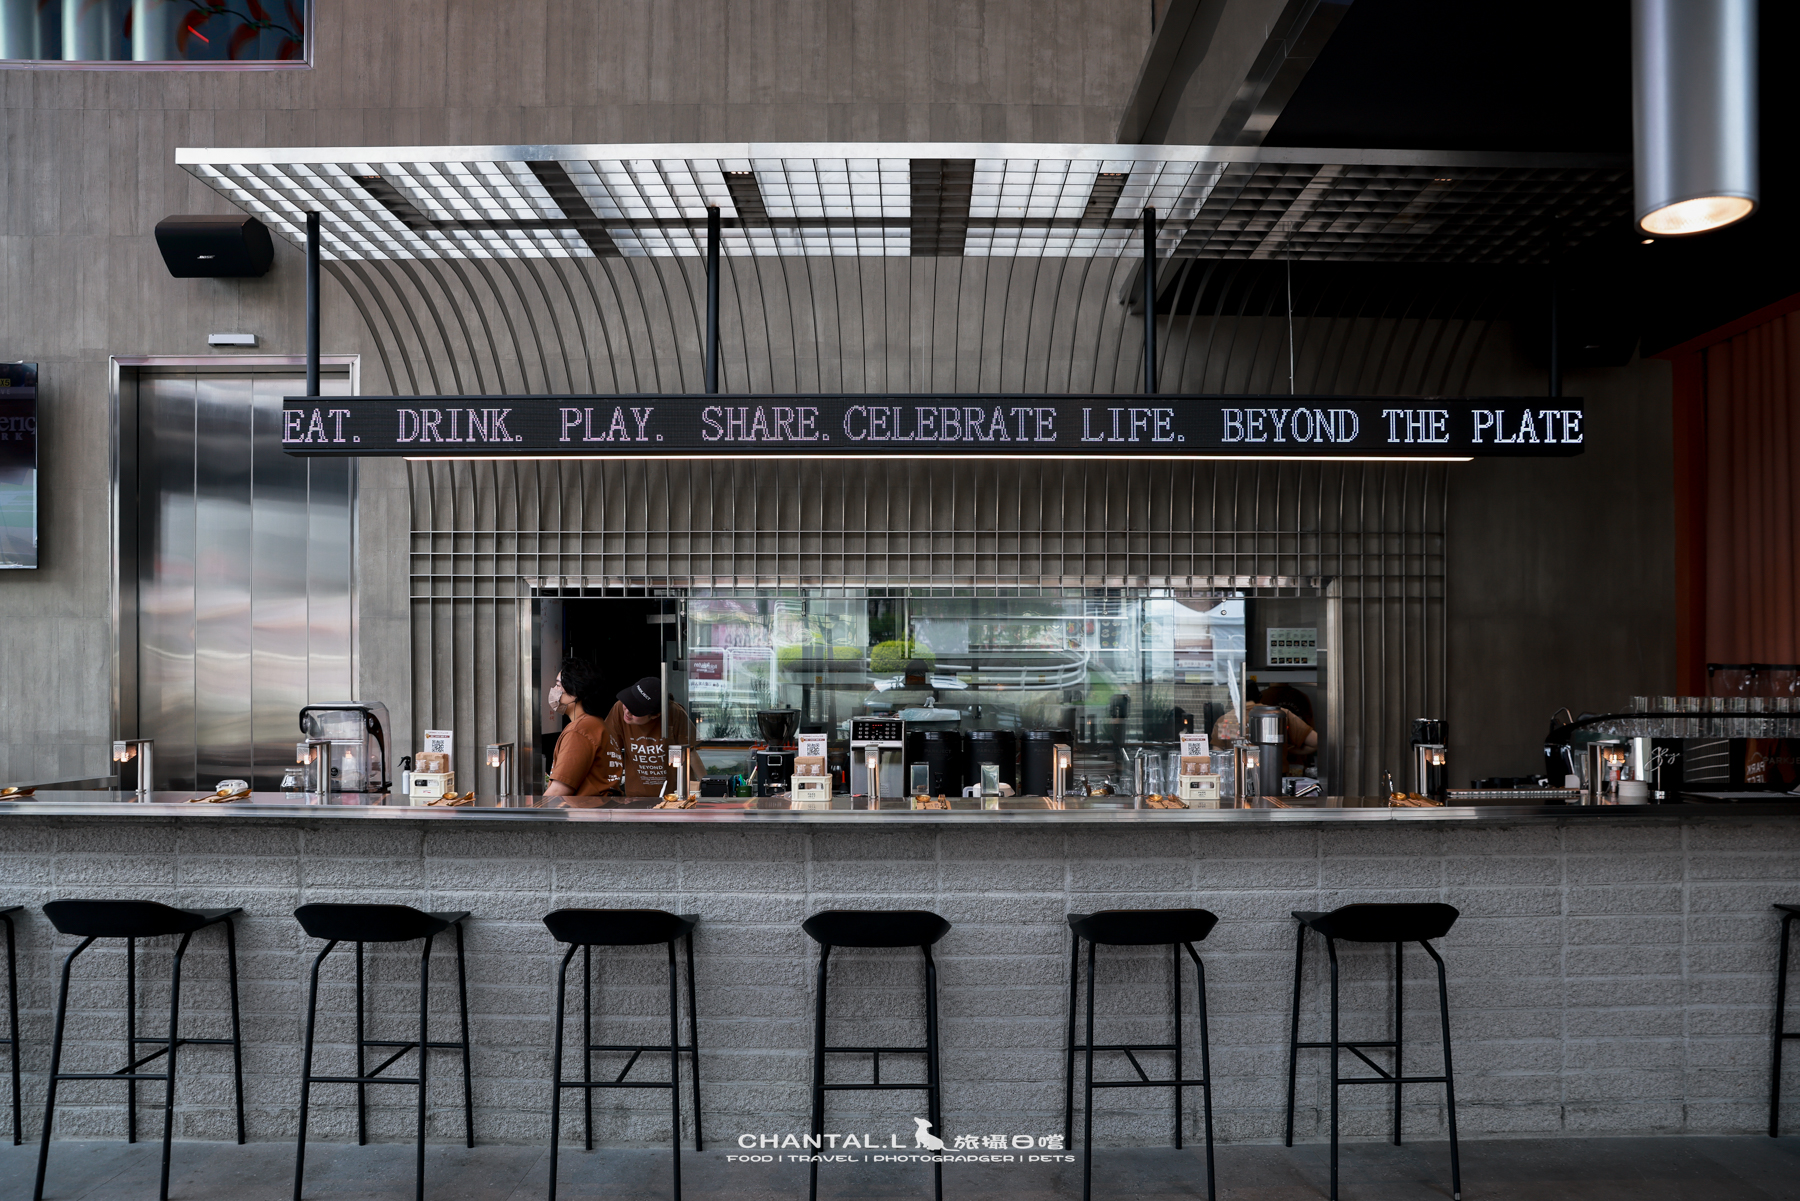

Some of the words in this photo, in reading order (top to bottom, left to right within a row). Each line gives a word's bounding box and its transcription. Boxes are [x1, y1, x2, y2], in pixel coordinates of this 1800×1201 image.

[282, 408, 361, 443] EAT.
[397, 408, 522, 443] DRINK.
[559, 407, 663, 442] PLAY.
[701, 406, 829, 442] SHARE.
[844, 406, 1057, 442] CELEBRATE
[1081, 407, 1184, 442] LIFE.
[1220, 408, 1359, 442] BEYOND
[1381, 408, 1449, 442] THE
[1472, 409, 1583, 443] PLATE
[630, 743, 665, 754] PARK
[632, 754, 666, 763] JECT
